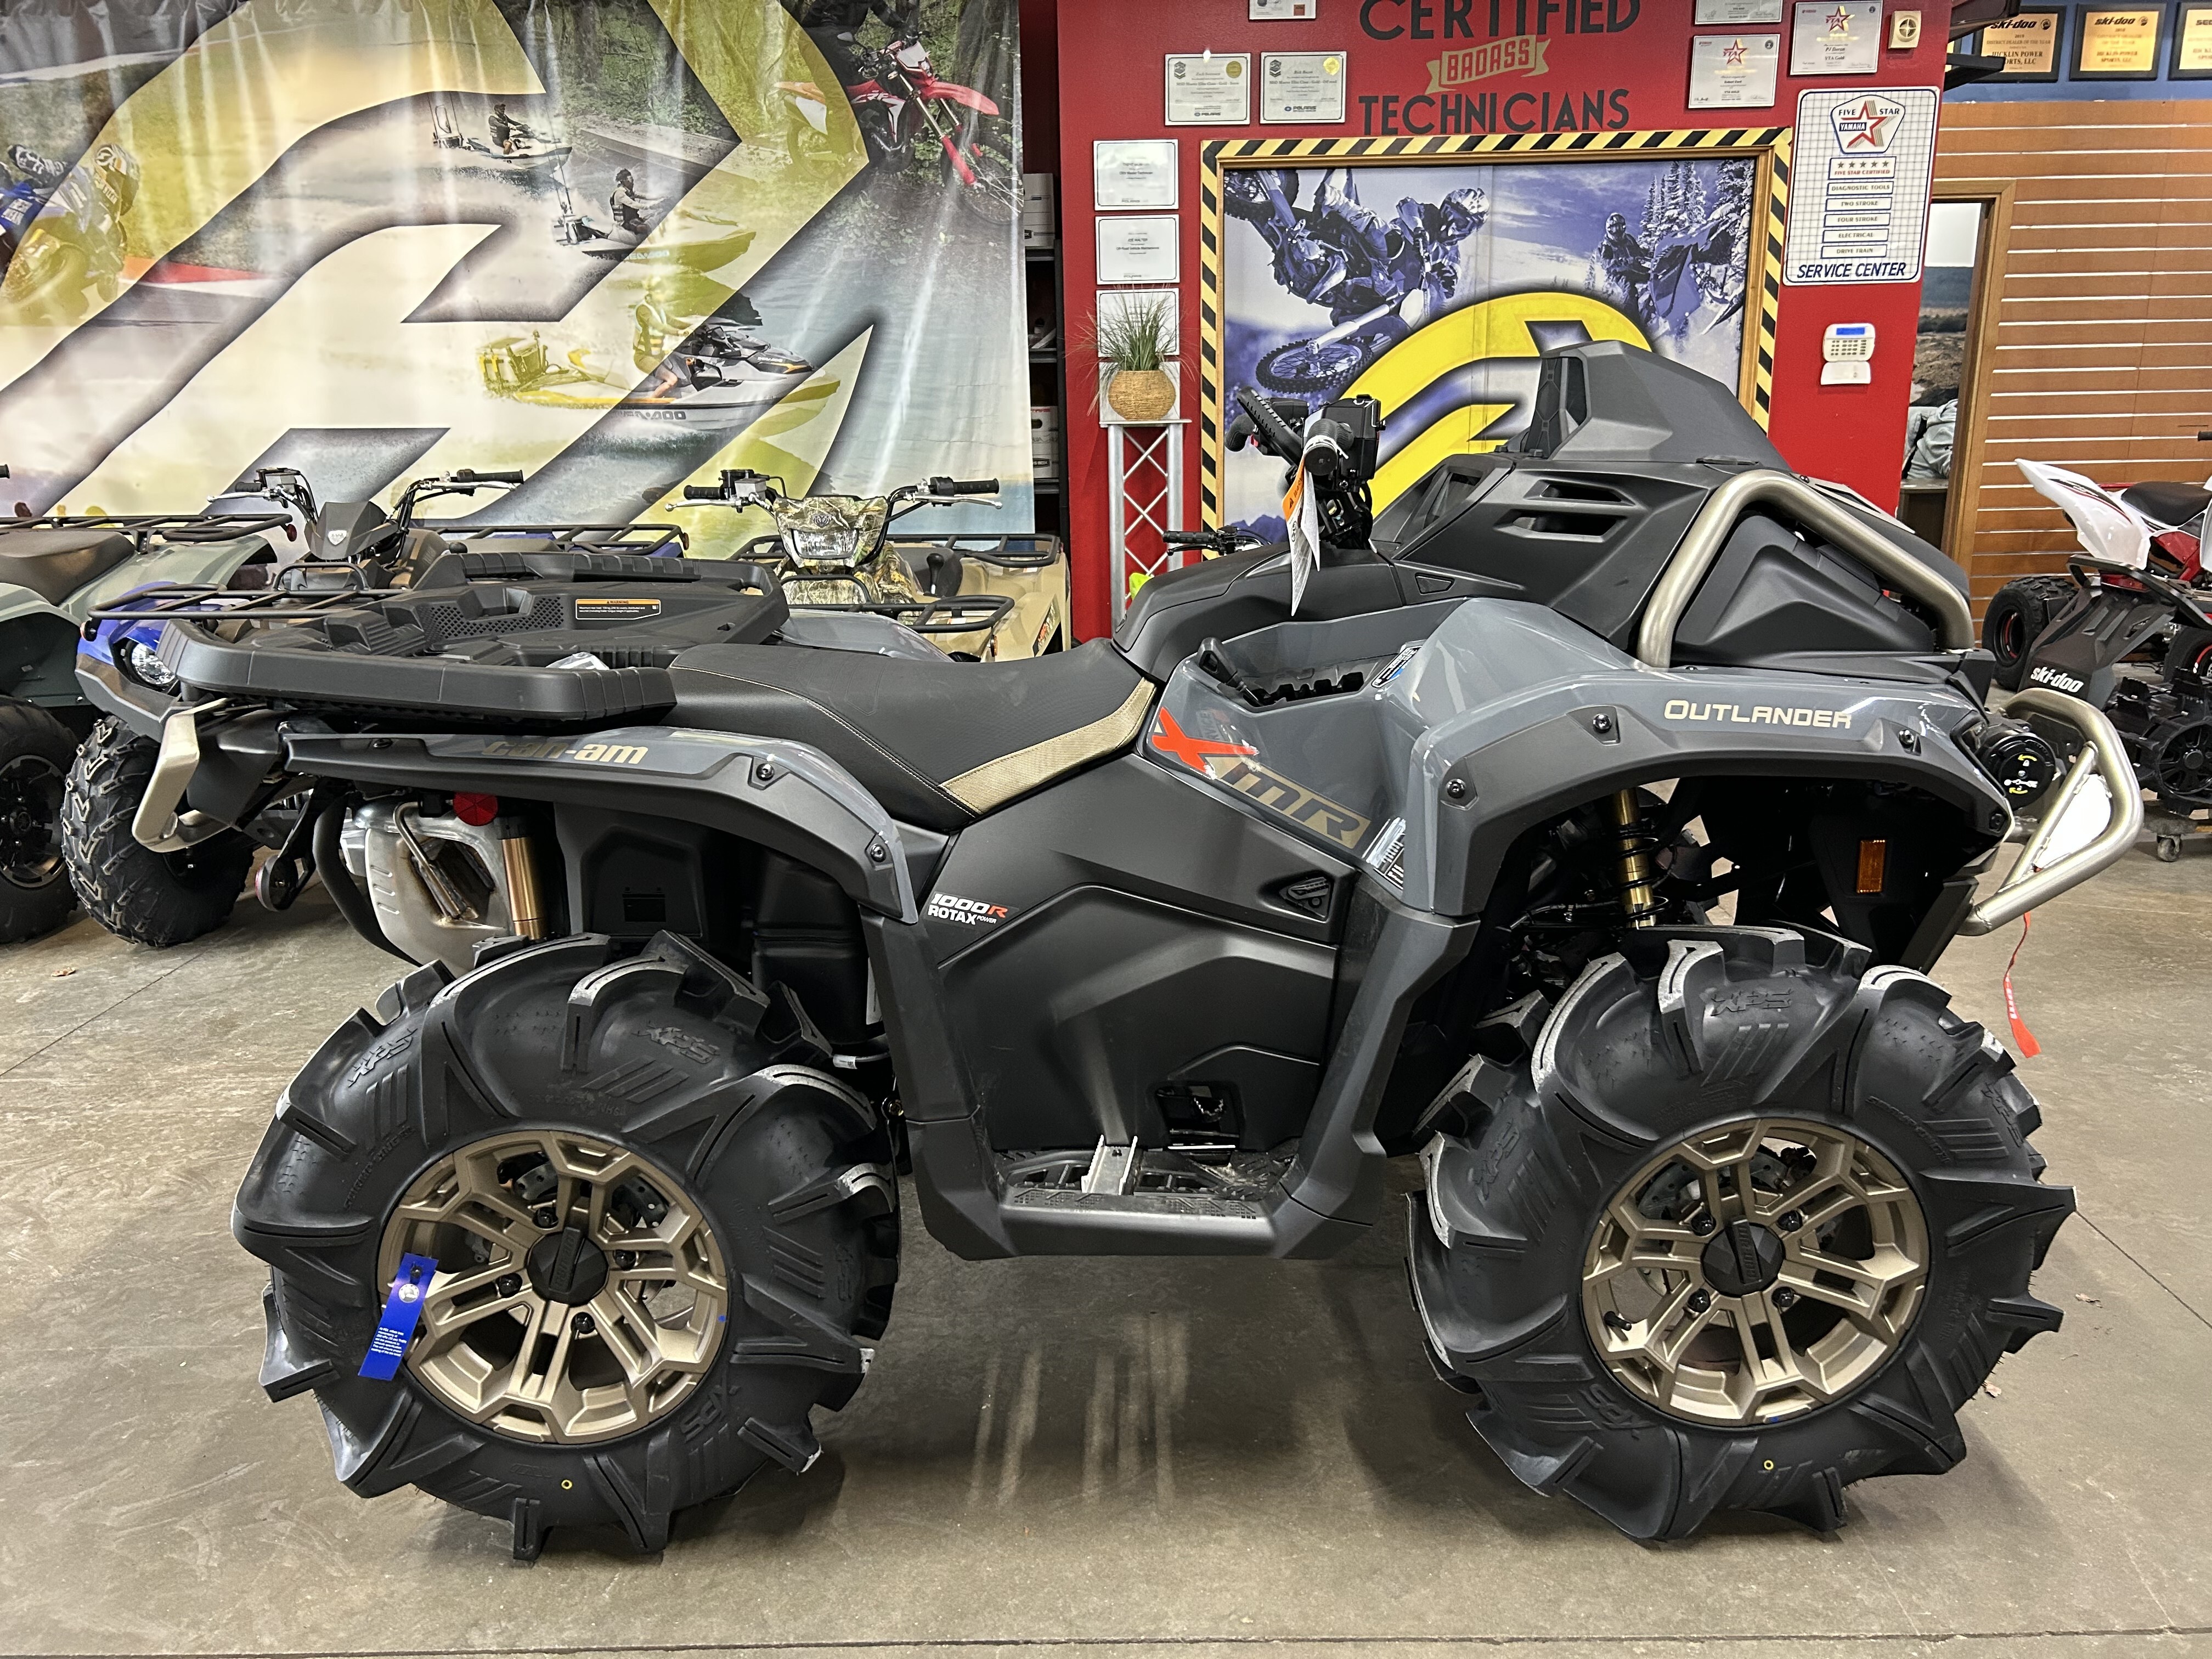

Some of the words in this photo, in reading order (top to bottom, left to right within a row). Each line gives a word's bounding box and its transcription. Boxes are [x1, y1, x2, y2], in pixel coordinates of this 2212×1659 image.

[1359, 0, 1640, 41] CERTIFIED
[2094, 16, 2136, 25] ski-doo
[1447, 38, 1530, 82] BADASS
[1358, 88, 1629, 136] TECHNICIANS
[1797, 263, 1853, 278] SERVICE
[1855, 262, 1906, 276] CENTER
[2030, 667, 2084, 693] ski-doo
[1664, 699, 1852, 729] OUTLANDER
[482, 741, 648, 764] can-am
[1152, 707, 1260, 780] X
[928, 905, 978, 926] ROTAX
[977, 915, 997, 924] POWER
[931, 893, 1008, 918] 1000R
